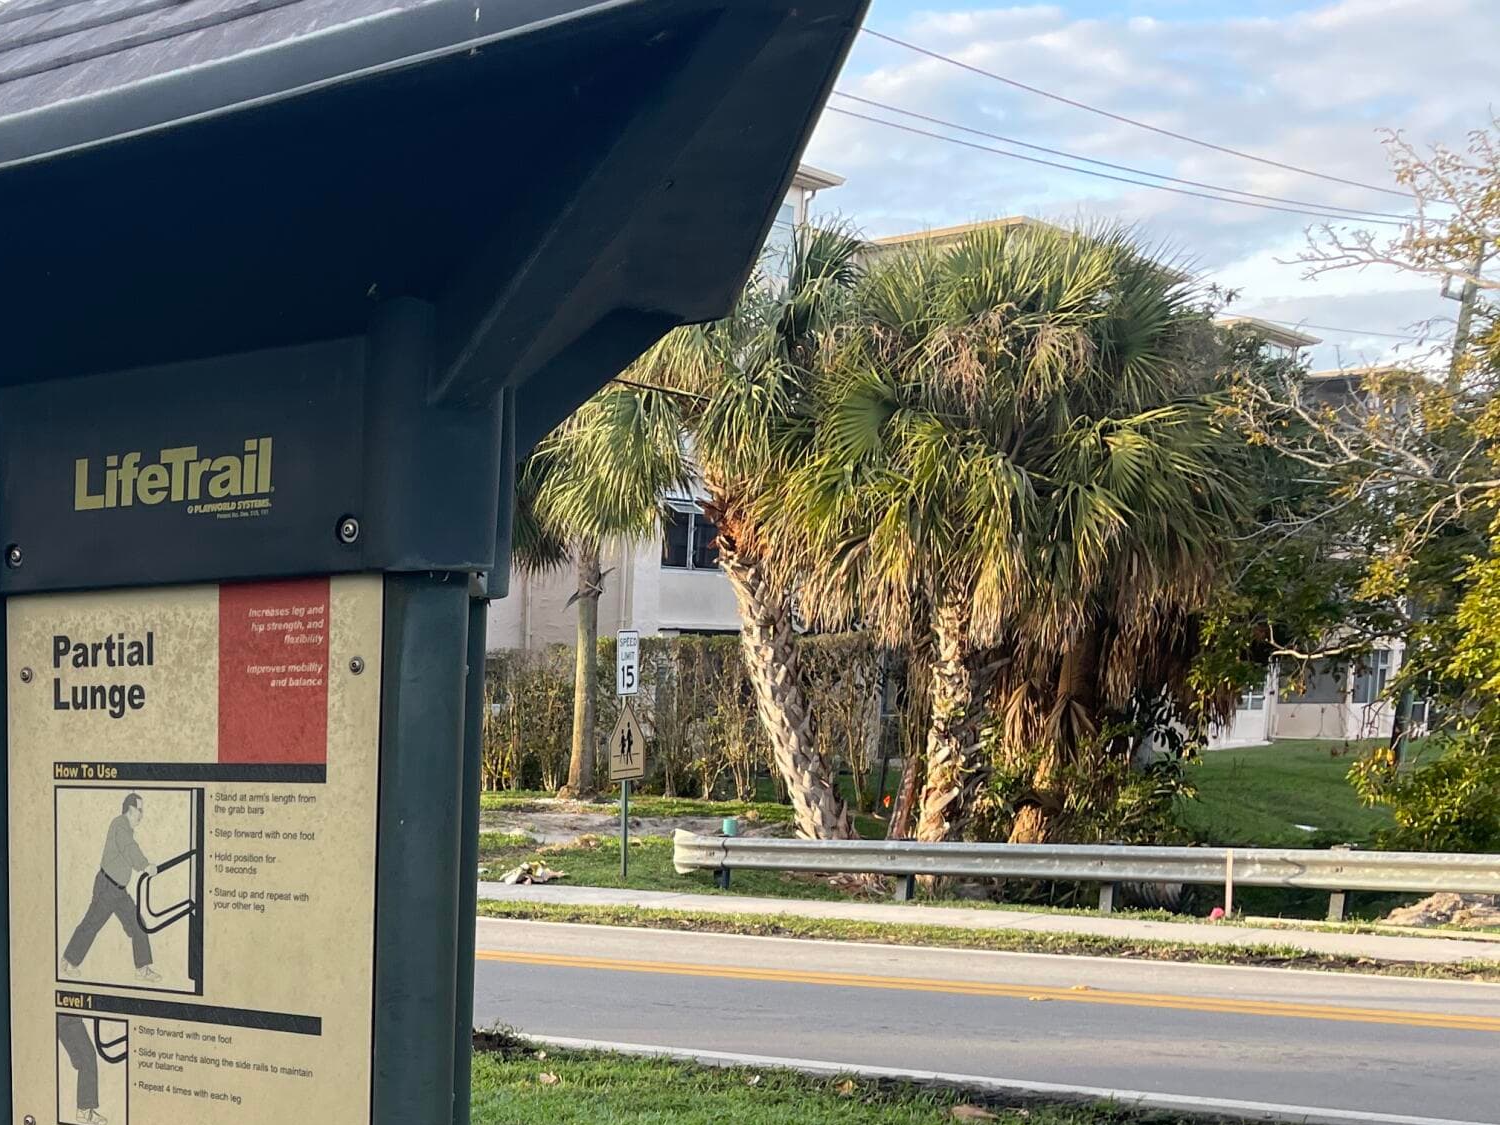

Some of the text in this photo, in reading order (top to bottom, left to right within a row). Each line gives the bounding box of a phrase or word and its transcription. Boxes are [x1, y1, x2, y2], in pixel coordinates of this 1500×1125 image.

[75, 437, 272, 510] LifeTrail
[195, 502, 236, 514] PLAYWORLD
[249, 605, 324, 617] Increases leg and
[252, 619, 324, 633] hip strength, and
[284, 635, 323, 645] flexibility
[620, 637, 637, 647] SPEED
[54, 632, 154, 668] Partial
[621, 652, 635, 661] LIMIT
[247, 662, 323, 675] Improves mobility
[271, 677, 322, 687] and balance
[622, 665, 634, 689] 15
[54, 678, 145, 719] Lunge
[55, 764, 118, 779] How To Use
[215, 793, 316, 805] Stand at arm's length from
[214, 805, 265, 815] the grab bars
[215, 828, 315, 840] Step forward with one foot
[215, 852, 276, 864] Hold position for
[215, 865, 257, 875] 10 seconds
[214, 888, 309, 902] Stand up and repeat with
[213, 901, 265, 913] your other leg
[57, 992, 92, 1009] Level 1
[139, 1026, 155, 1035] Step
[157, 1028, 184, 1039] forward
[186, 1032, 200, 1040] with
[218, 1034, 232, 1044] foot
[138, 1061, 183, 1072] your balance
[139, 1048, 313, 1077] Slide your hands along the side rails to maintain
[139, 1081, 164, 1092] Repeat
[173, 1086, 191, 1096] times
[194, 1090, 209, 1098] with
[211, 1092, 228, 1101] each
[230, 1094, 241, 1105] leg
